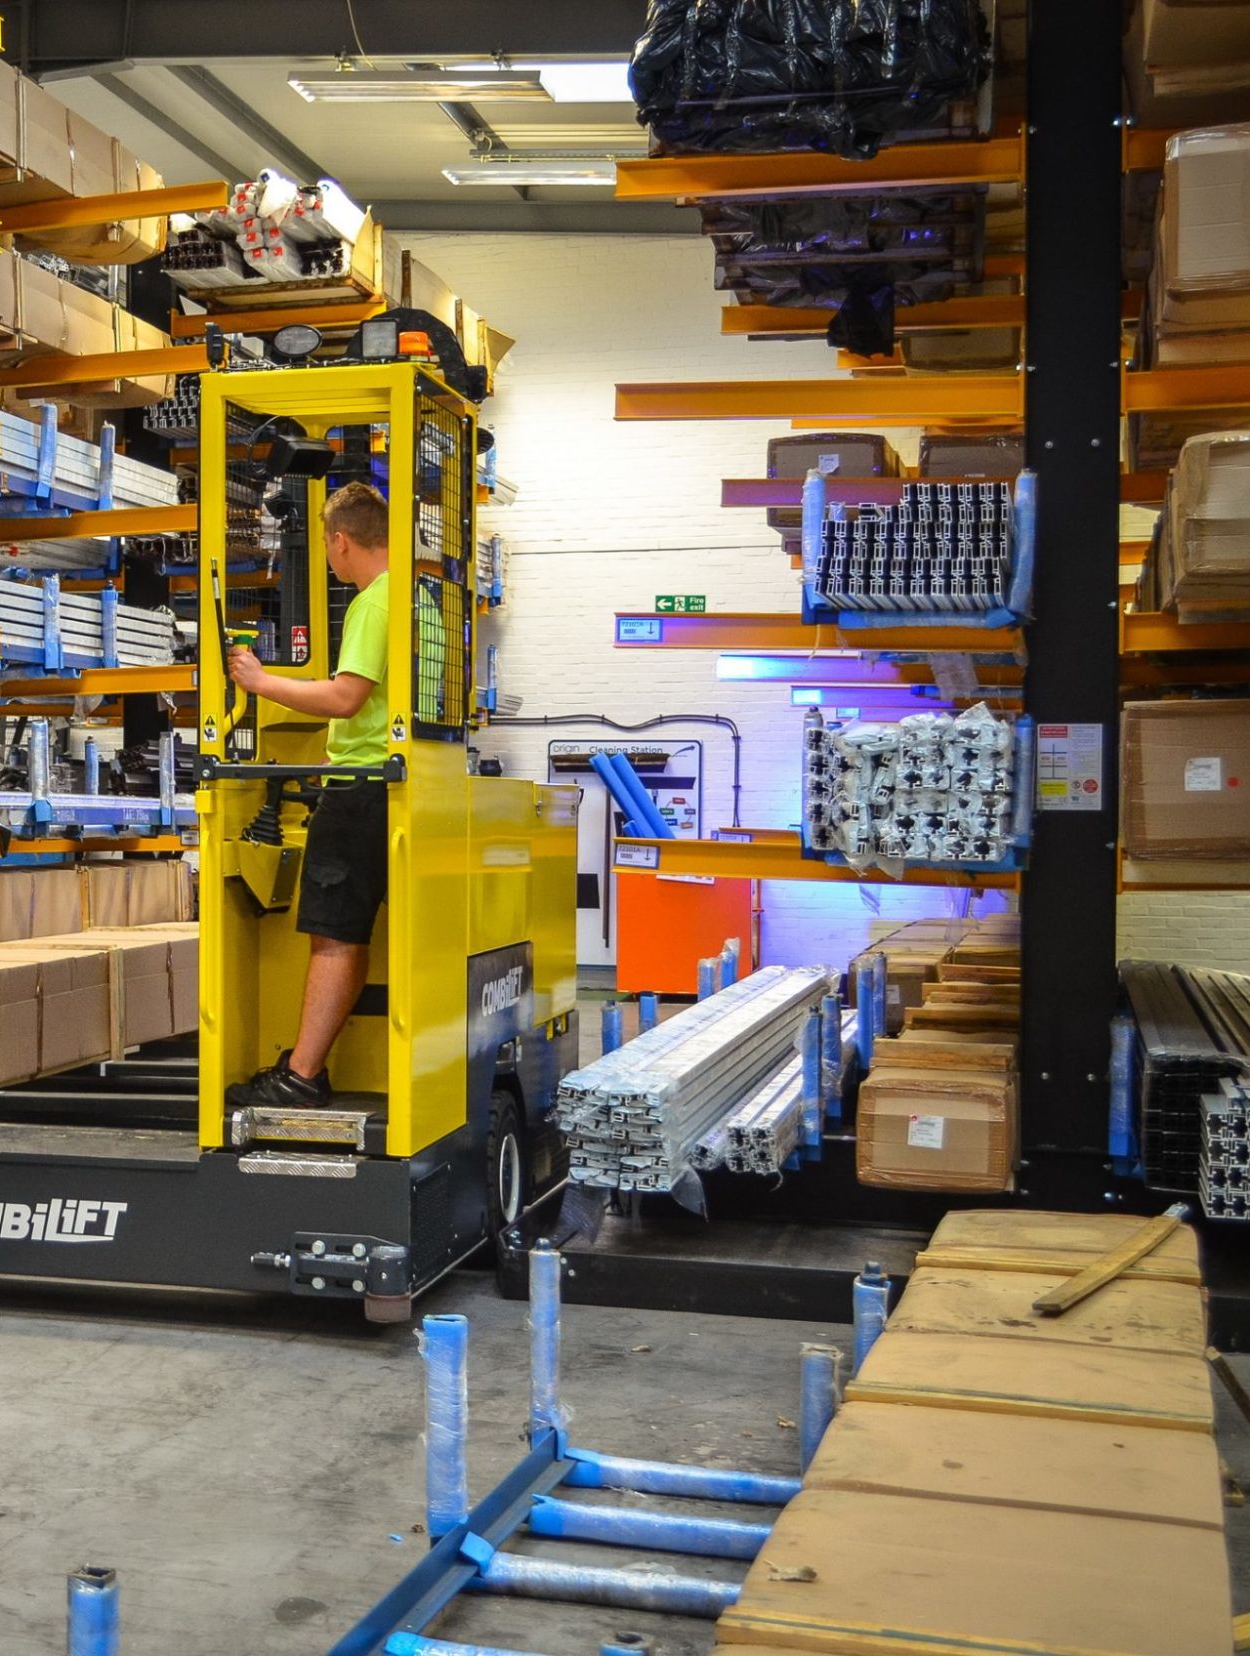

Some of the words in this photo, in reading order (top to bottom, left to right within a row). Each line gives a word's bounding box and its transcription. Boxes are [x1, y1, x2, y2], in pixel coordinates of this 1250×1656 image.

[553, 744, 580, 754] origin
[589, 745, 628, 755] Cleaning
[631, 745, 663, 754] Station
